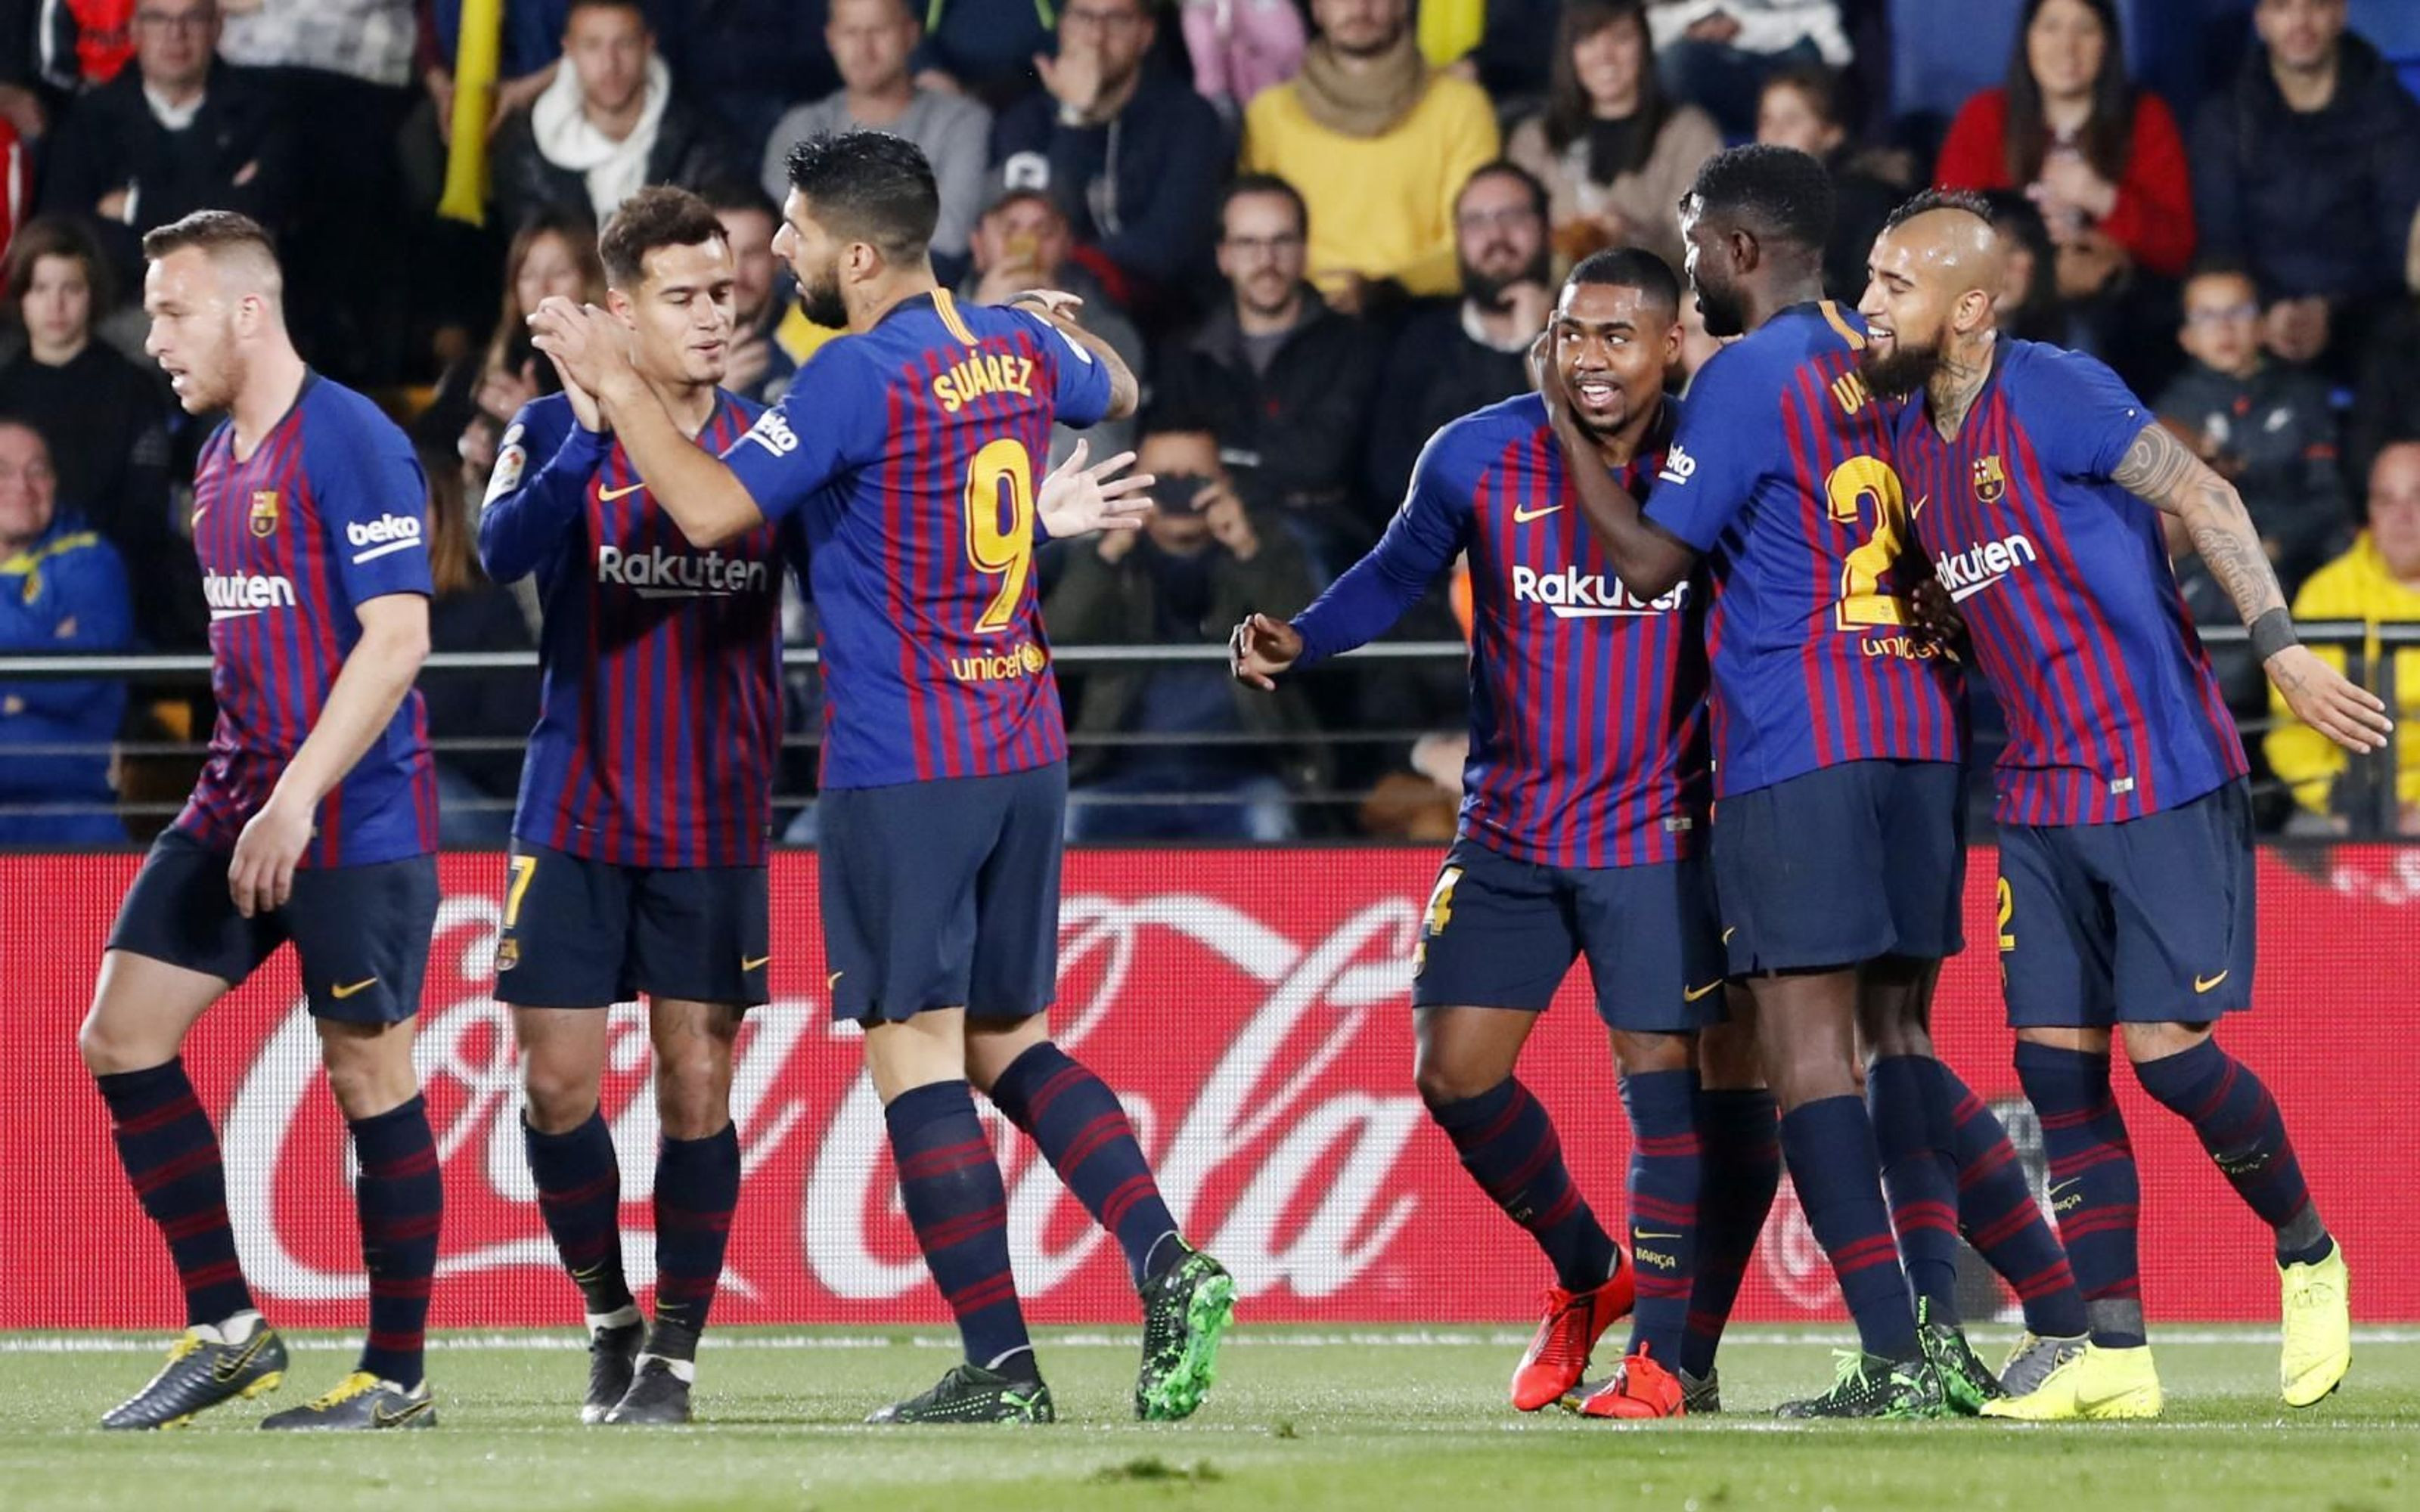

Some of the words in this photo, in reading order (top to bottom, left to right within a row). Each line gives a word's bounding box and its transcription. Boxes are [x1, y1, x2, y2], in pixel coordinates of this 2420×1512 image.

[933, 349, 1032, 412] SUÁREZ
[346, 513, 420, 546] beko
[964, 438, 1034, 634] 9
[598, 545, 768, 592] Rakuten
[951, 645, 1022, 681] unicef
[503, 855, 538, 929] 7
